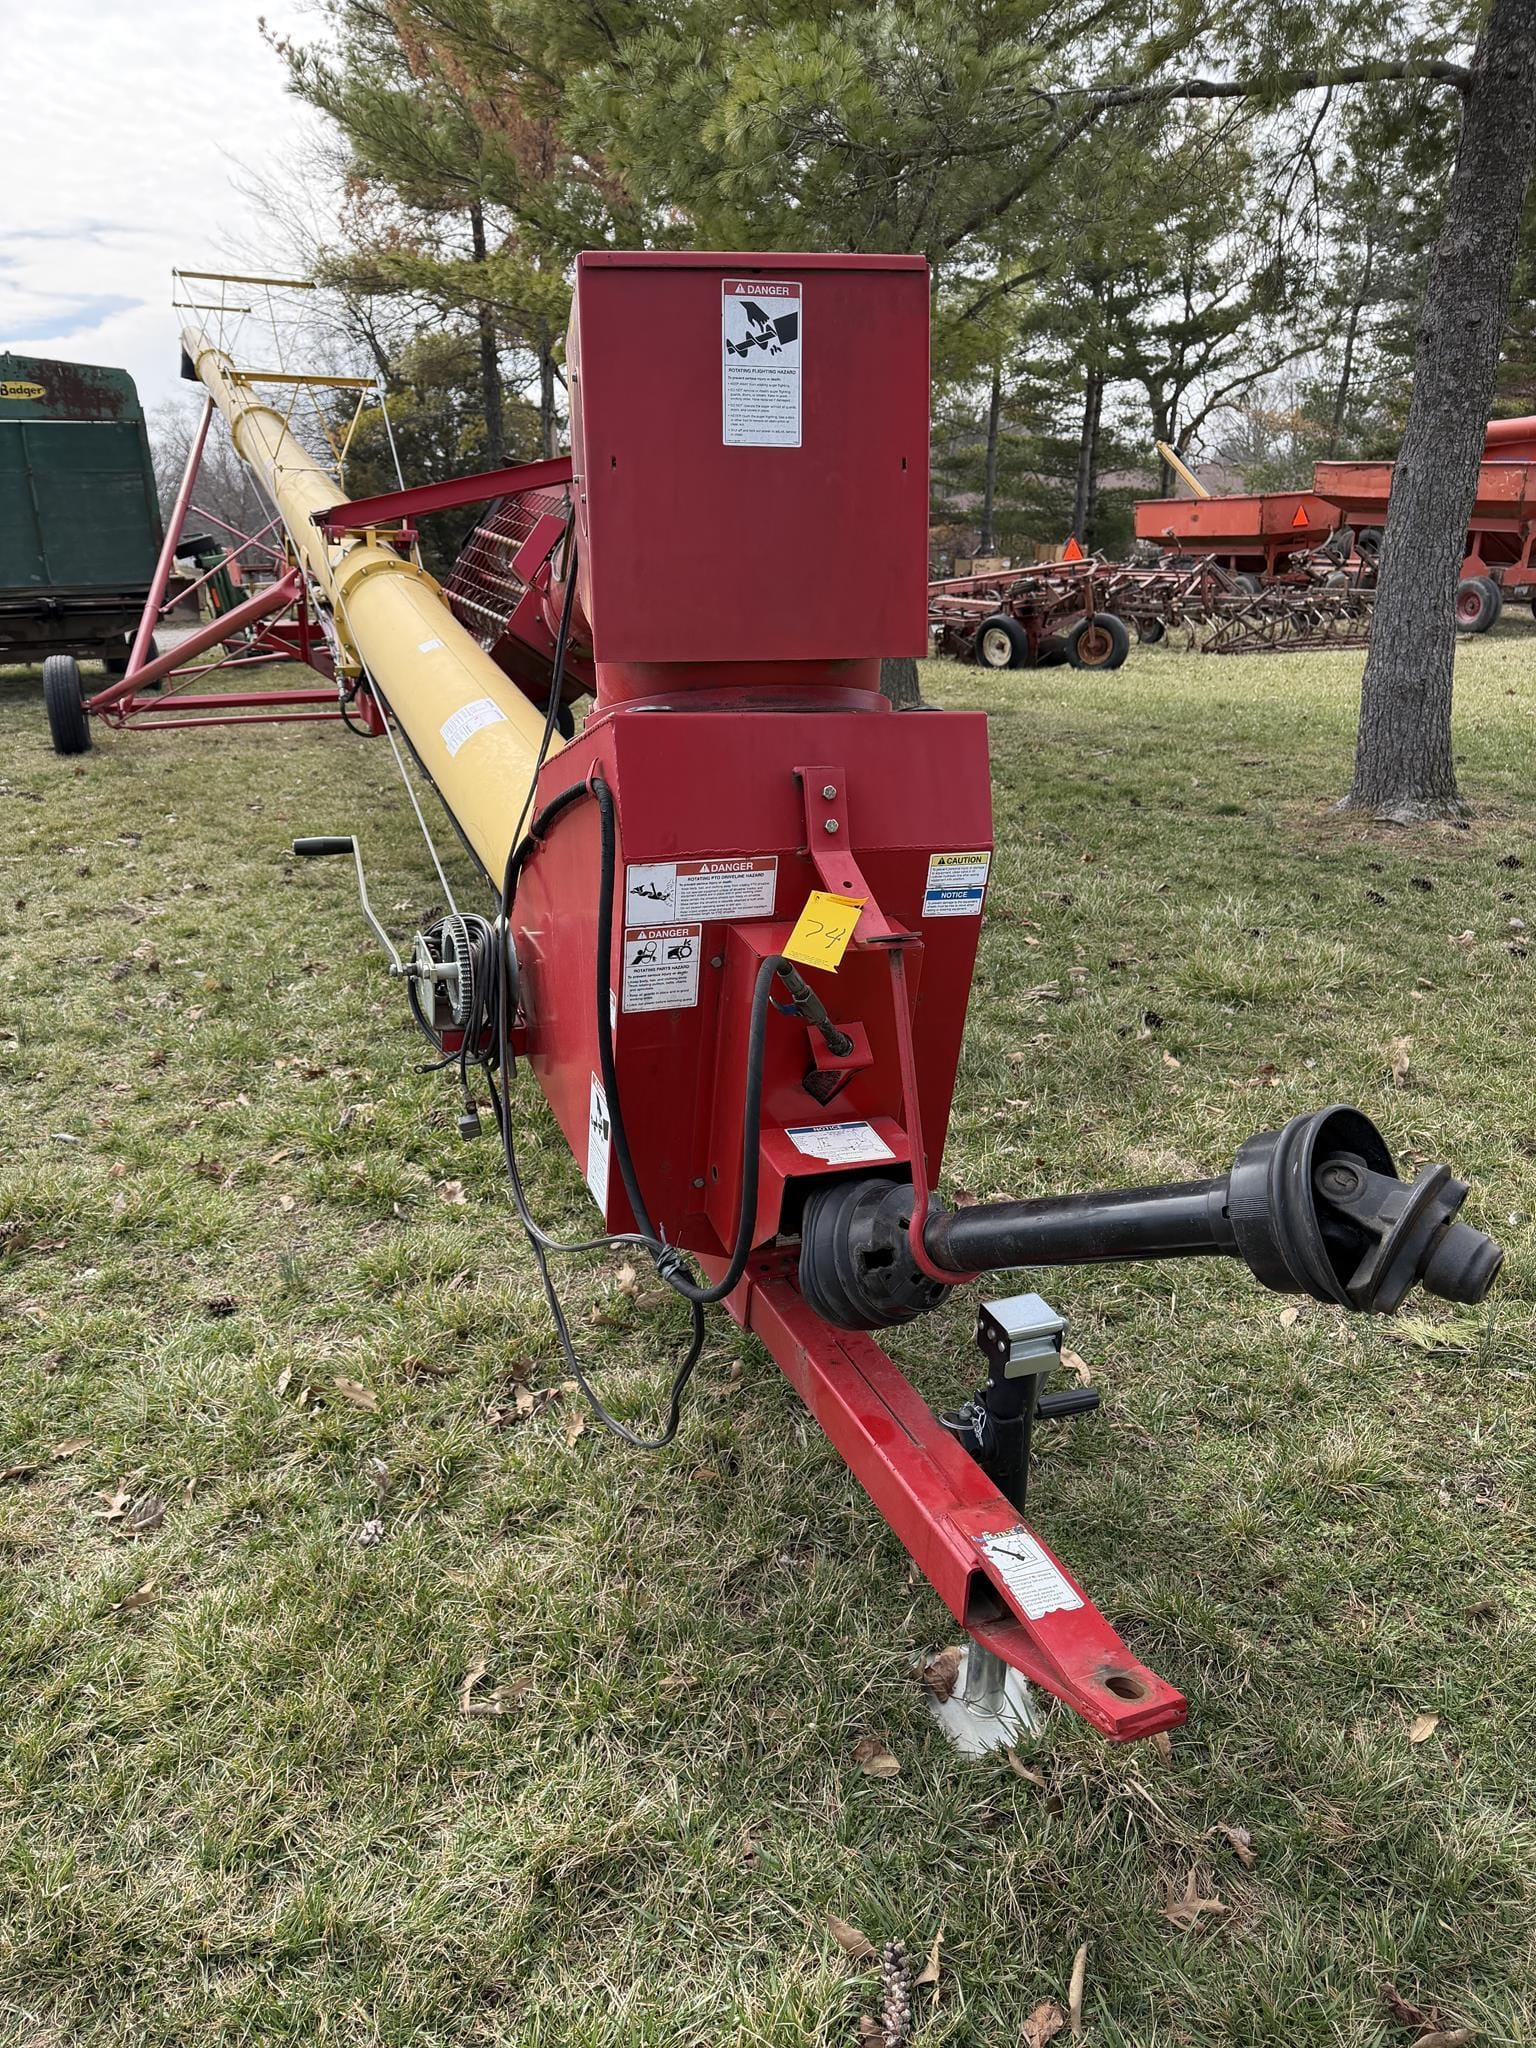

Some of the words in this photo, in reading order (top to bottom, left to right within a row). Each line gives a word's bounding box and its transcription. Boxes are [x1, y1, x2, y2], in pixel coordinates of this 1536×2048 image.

[747, 285, 789, 296] DANGER
[1, 384, 42, 397] Badger
[946, 856, 982, 864] CAUTION
[711, 862, 753, 873] DANGER
[940, 891, 969, 899] NOTICE
[648, 928, 689, 939] DANGER
[805, 919, 846, 949] 74
